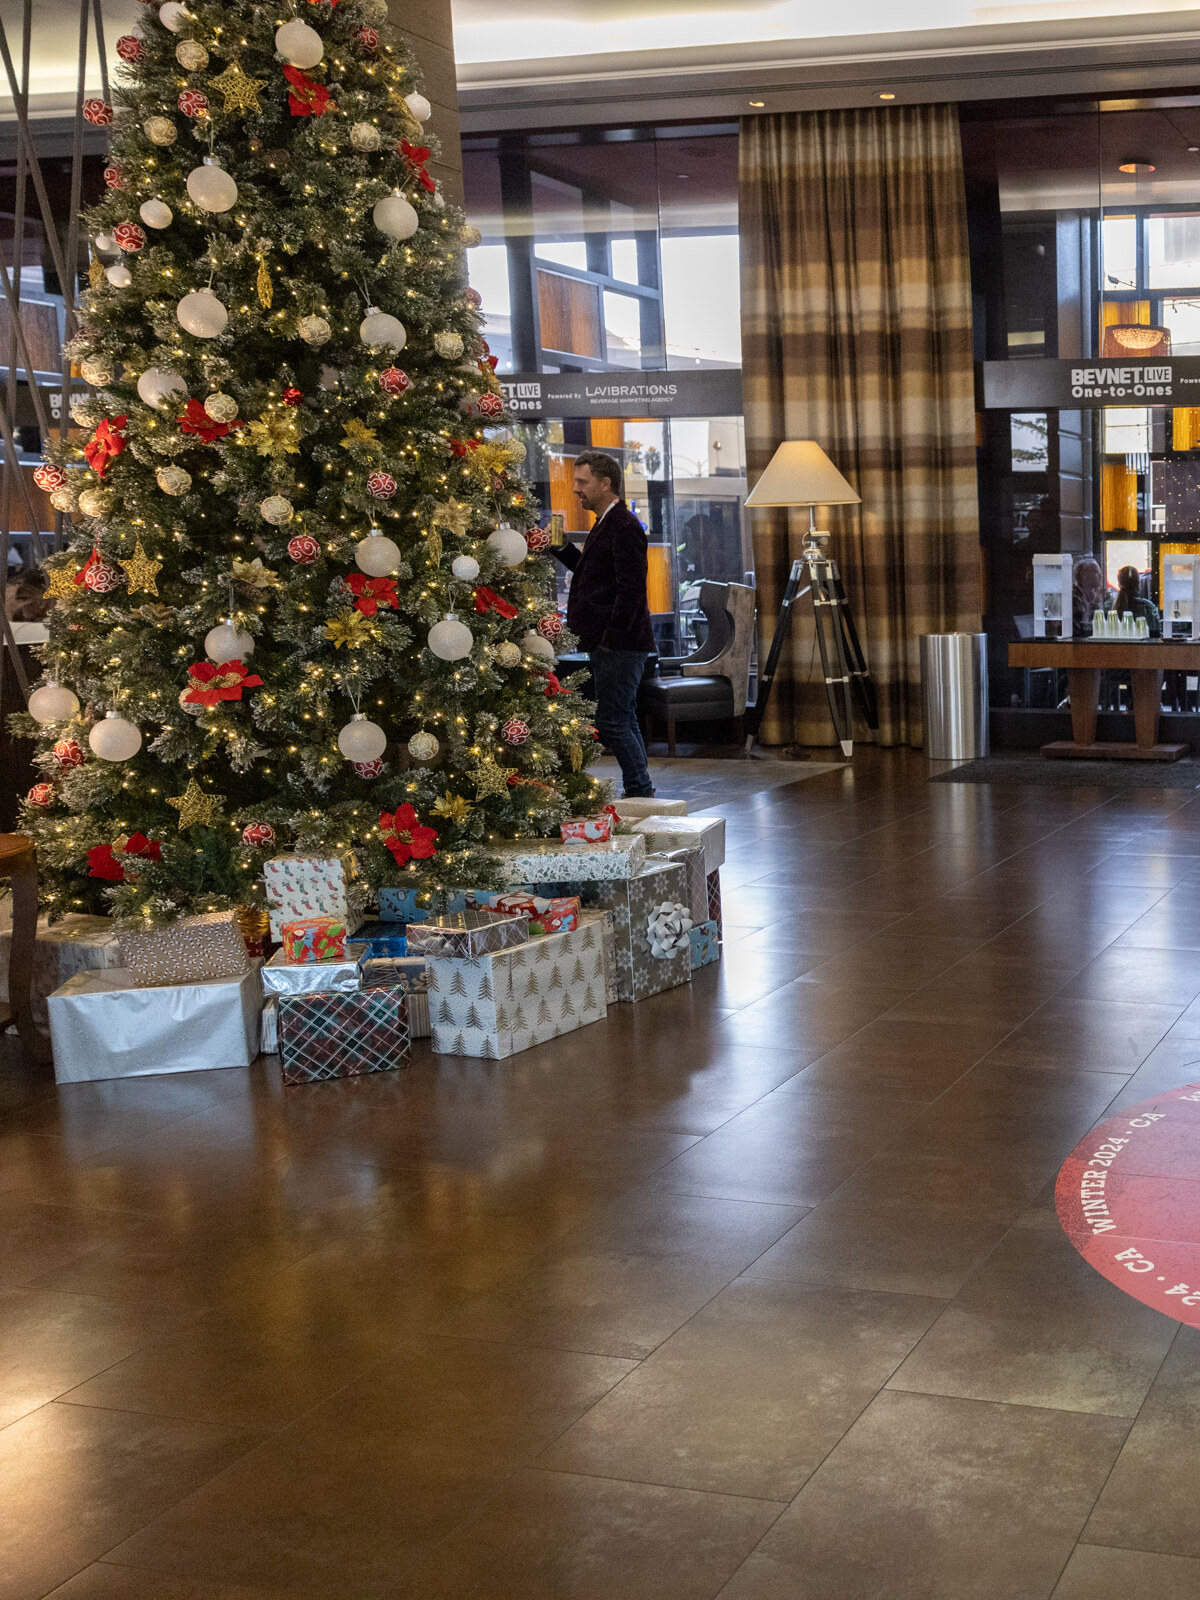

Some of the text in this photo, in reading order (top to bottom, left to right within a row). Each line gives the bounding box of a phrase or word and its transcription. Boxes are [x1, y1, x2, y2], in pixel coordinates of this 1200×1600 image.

[1144, 366, 1172, 382] LIVE
[517, 383, 541, 398] LIVE
[585, 385, 677, 396] LAVIBRATIONS
[1071, 385, 1172, 398] One-to-Ones
[1081, 1110, 1166, 1234] WINTER 2024 CA
[1114, 1247, 1154, 1273] CA
